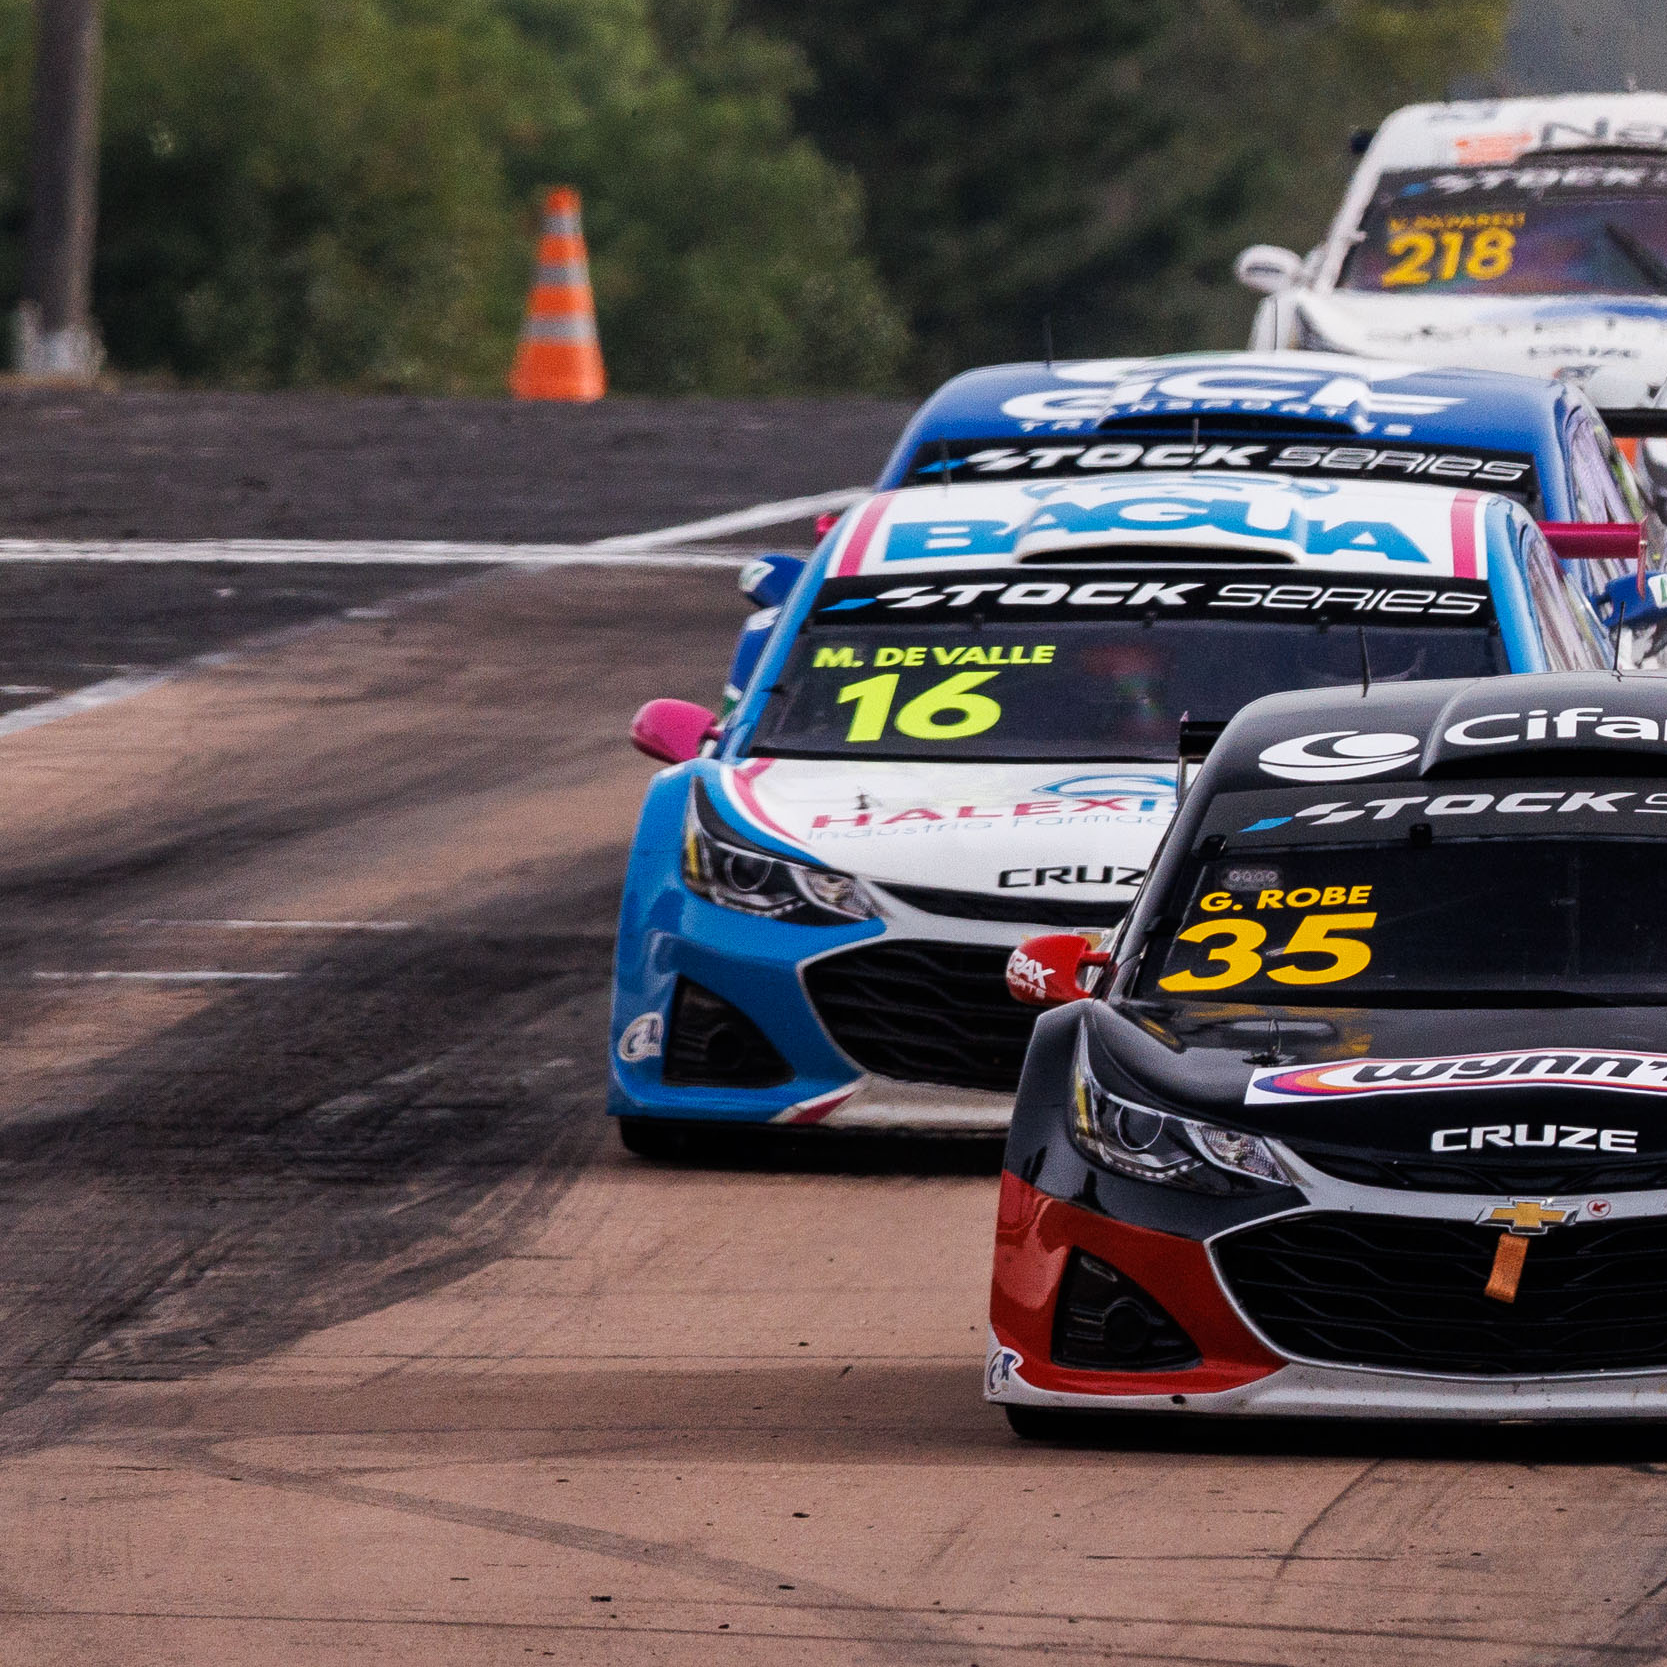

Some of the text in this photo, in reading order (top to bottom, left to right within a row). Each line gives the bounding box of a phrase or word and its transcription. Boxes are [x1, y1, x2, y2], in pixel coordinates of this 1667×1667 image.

[1381, 227, 1517, 289] 218
[964, 443, 1269, 471] STOCK
[876, 581, 1206, 609] STOCK
[812, 644, 1057, 669] M. DE VALLE
[836, 670, 1002, 743] 16
[811, 796, 1176, 829] HALEXI
[1295, 791, 1636, 825] STOCK
[999, 865, 1147, 888] CRUZ
[1199, 884, 1373, 913] G. ROBE
[1157, 911, 1378, 993] 35
[1429, 1123, 1638, 1154] CRUZE
